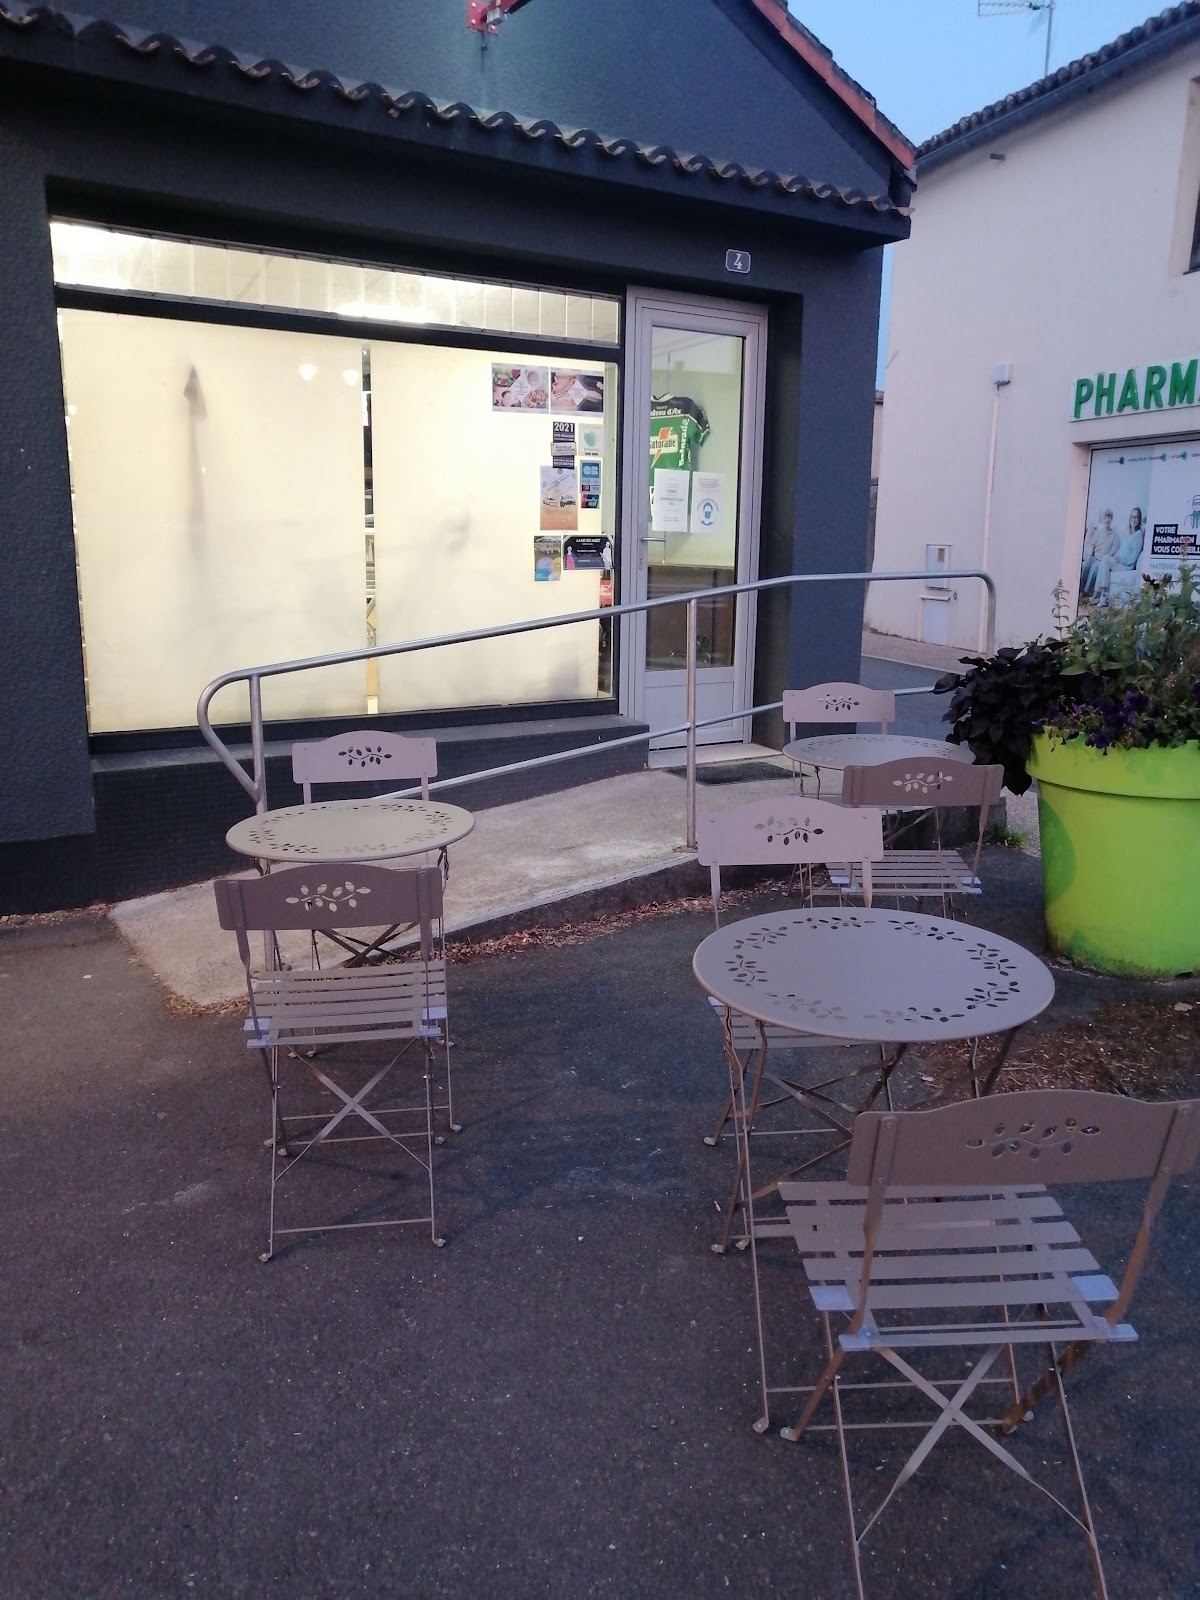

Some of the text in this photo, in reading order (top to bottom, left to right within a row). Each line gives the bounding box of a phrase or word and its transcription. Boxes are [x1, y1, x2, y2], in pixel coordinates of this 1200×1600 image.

[733, 253, 743, 270] 4
[1073, 359, 1200, 419] PHARM
[554, 422, 574, 433] 2021
[650, 440, 676, 449] atorade
[1155, 526, 1177, 534] VOTRE
[1153, 545, 1200, 554] VOUS COEILL
